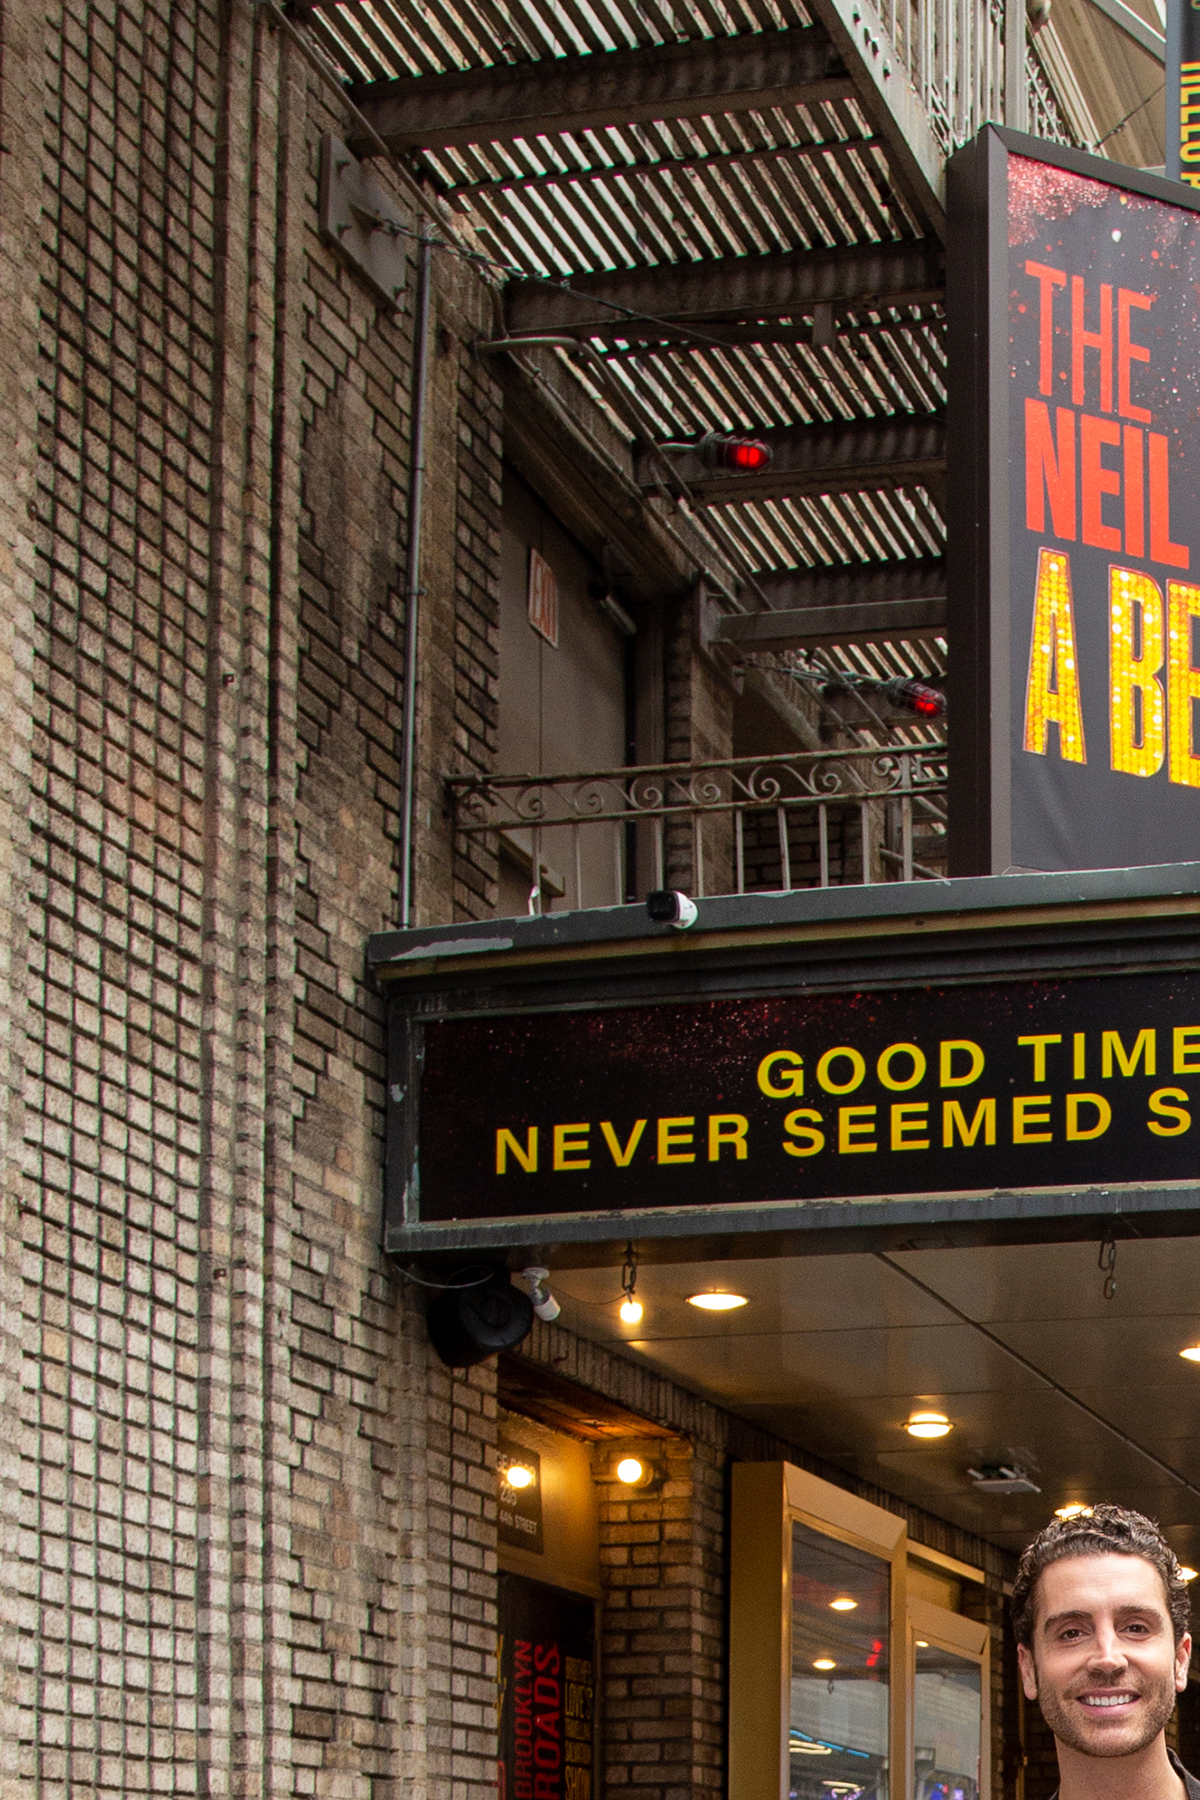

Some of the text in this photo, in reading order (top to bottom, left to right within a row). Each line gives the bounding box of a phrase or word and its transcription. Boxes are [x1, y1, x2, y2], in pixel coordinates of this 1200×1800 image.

[1024, 260, 1153, 424] THE
[1024, 398, 1191, 571] NEIL
[1022, 546, 1087, 765] A
[494, 1113, 751, 1176] NEVER
[782, 1092, 1114, 1160] SEEMED
[755, 1038, 988, 1101] GOOD
[514, 1640, 532, 1800] BROOKLYN
[534, 1642, 561, 1800] ROADS
